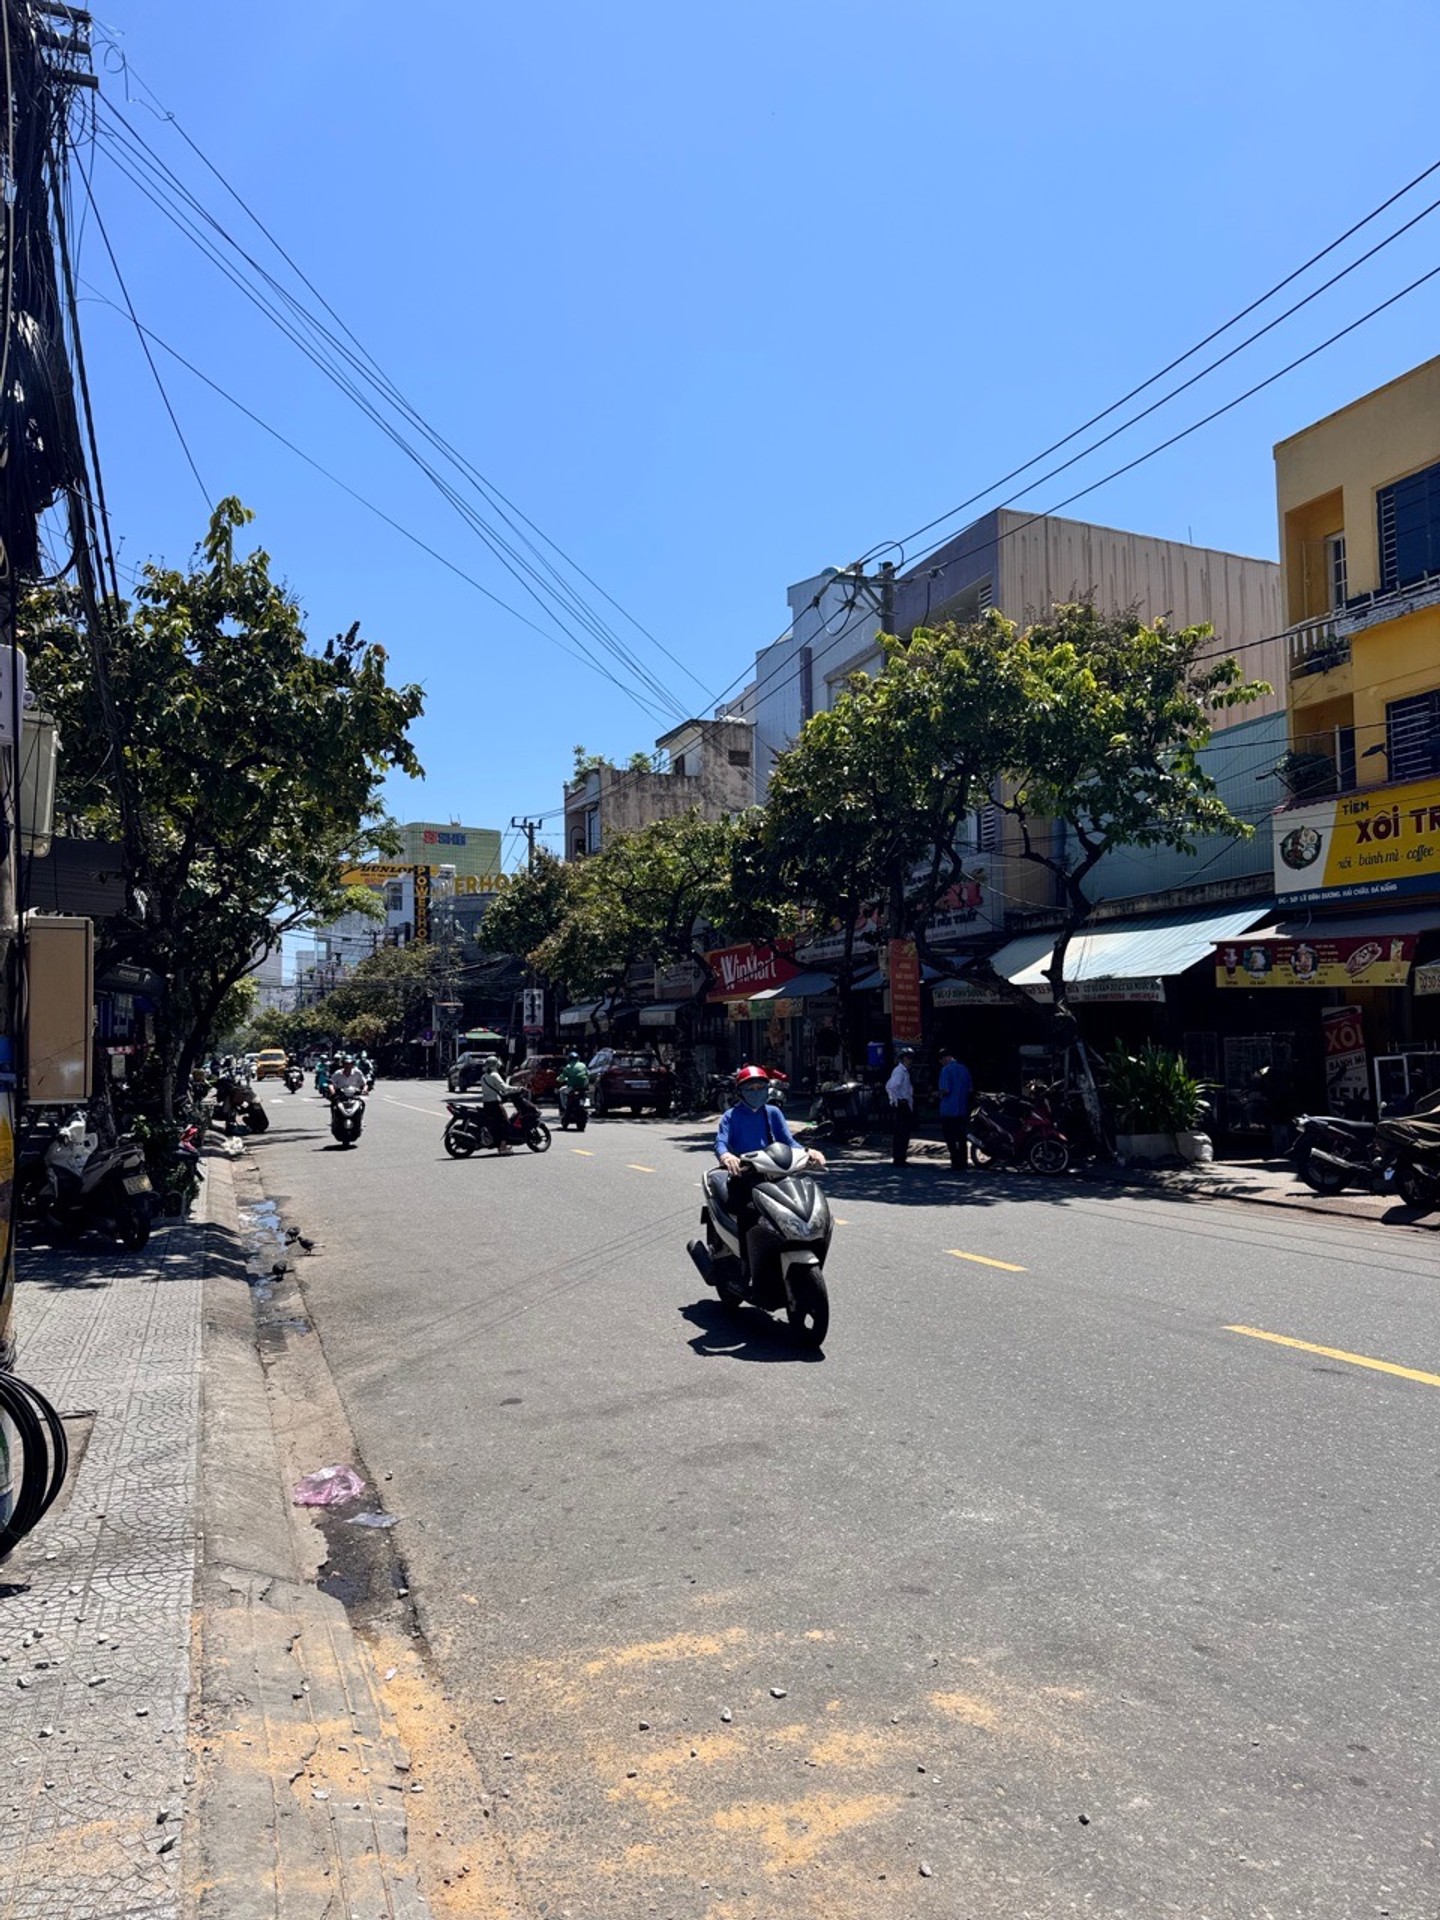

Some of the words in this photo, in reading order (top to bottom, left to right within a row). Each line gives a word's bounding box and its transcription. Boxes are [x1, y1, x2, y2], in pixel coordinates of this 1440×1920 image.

[1407, 844, 1433, 862] coffee
[720, 951, 777, 990] WinMart
[1325, 1021, 1364, 1052] XÔI
